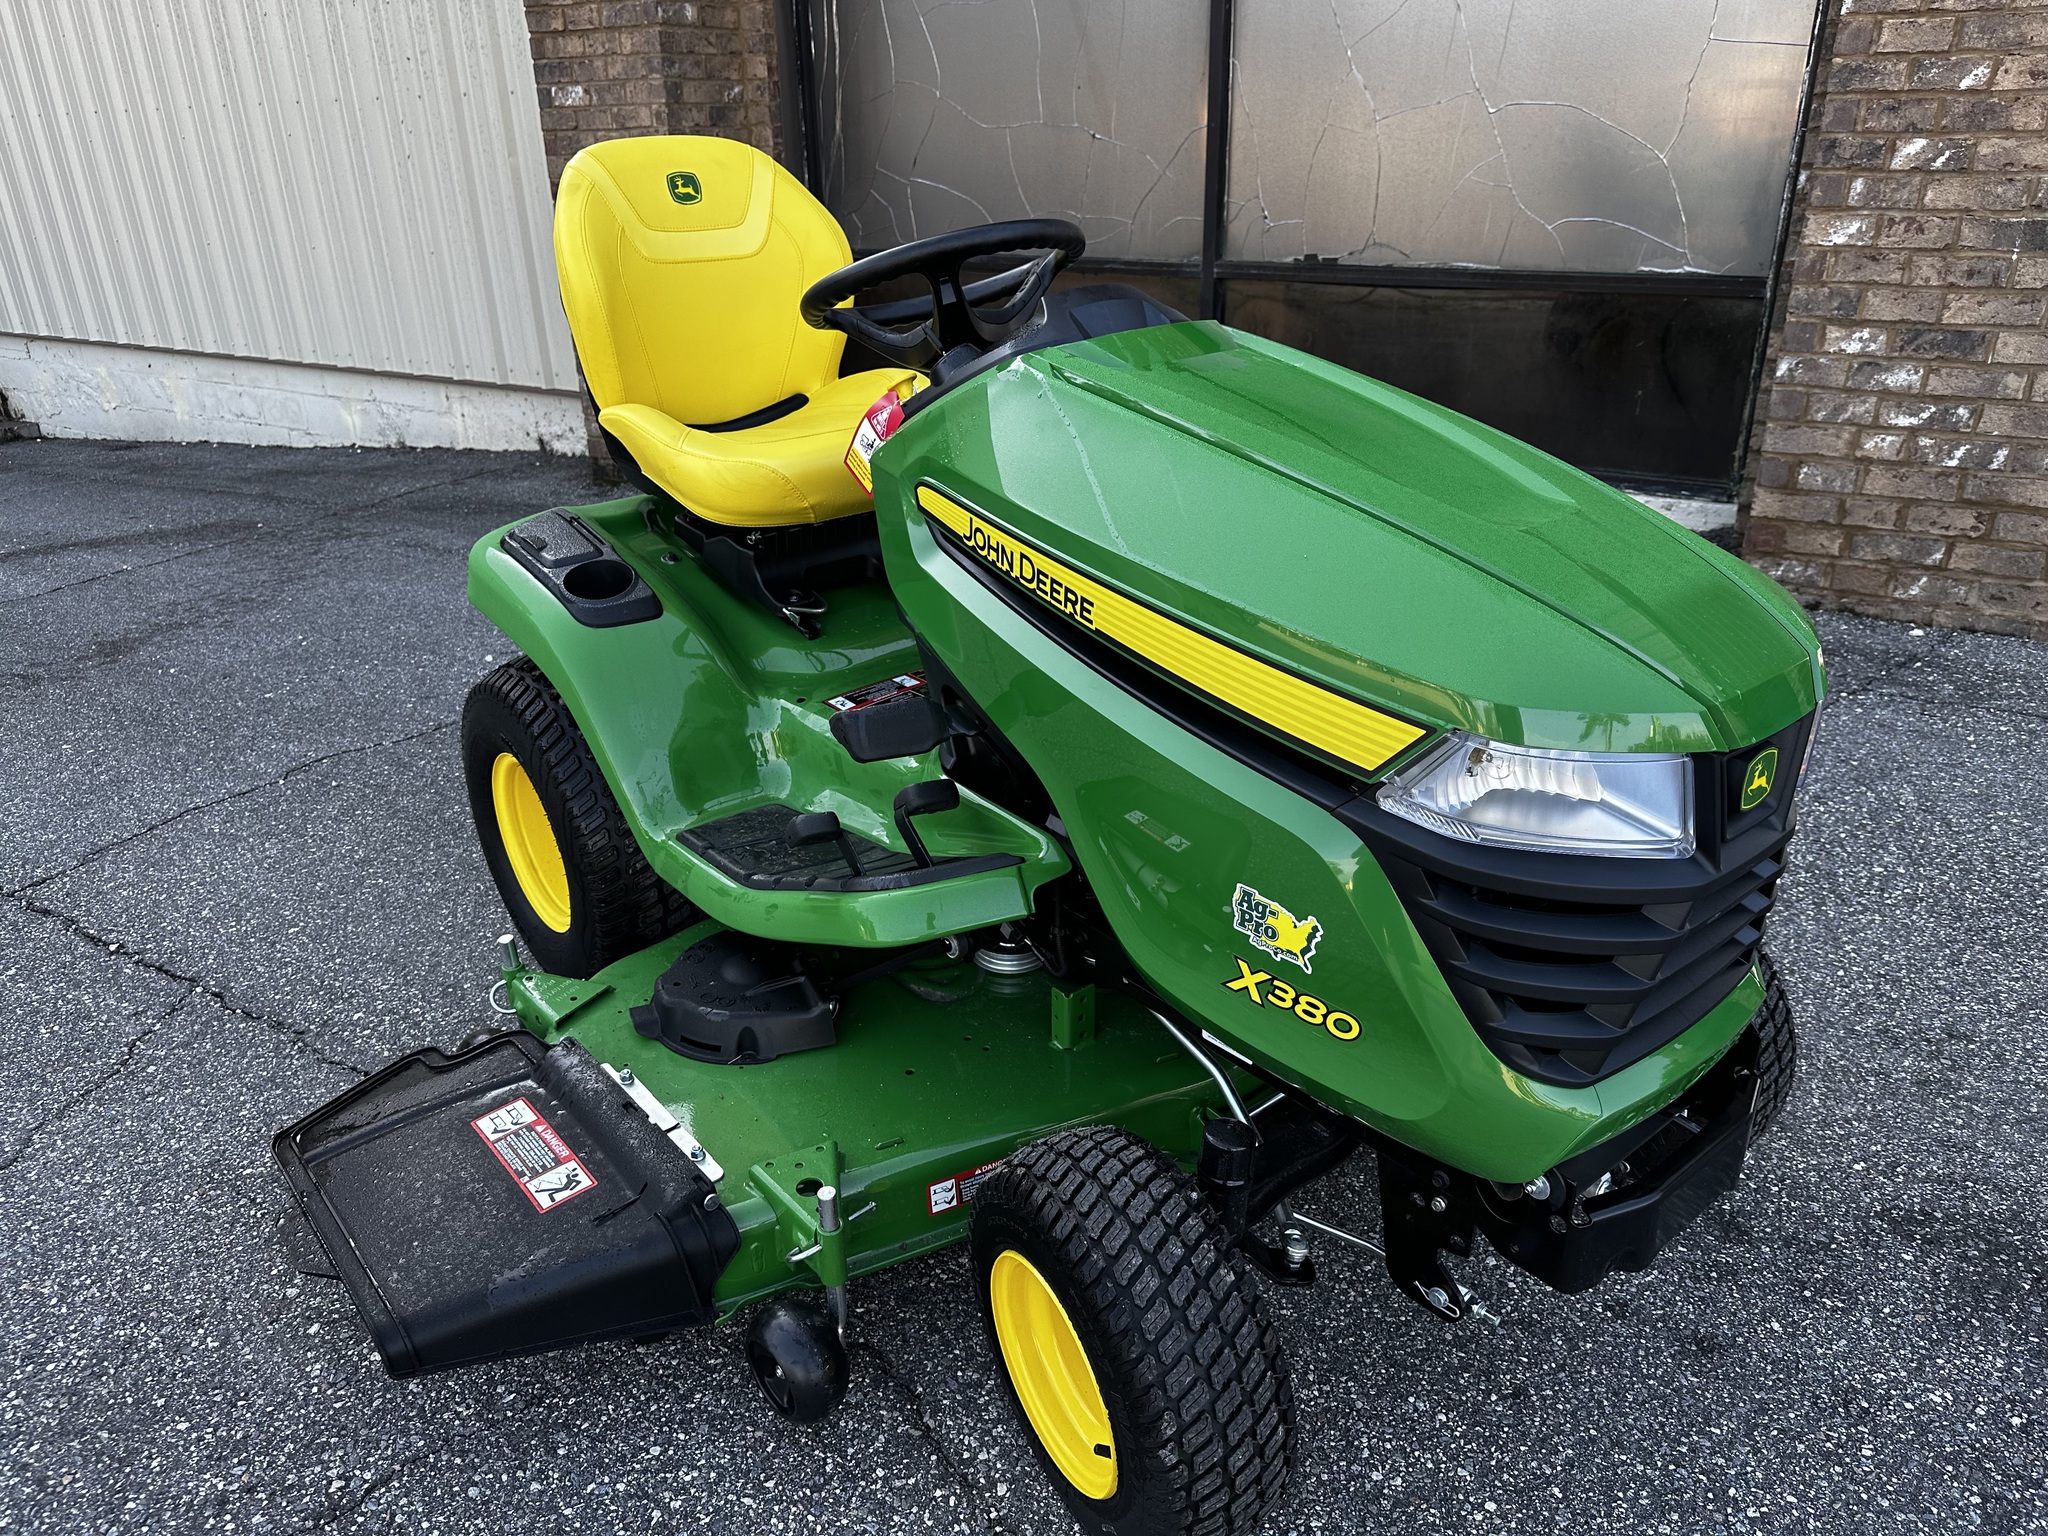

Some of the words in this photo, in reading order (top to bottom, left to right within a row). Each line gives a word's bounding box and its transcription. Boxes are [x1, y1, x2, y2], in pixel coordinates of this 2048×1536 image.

[963, 516, 1014, 575] JOHN
[1019, 550, 1095, 627] DEERE
[1237, 888, 1278, 920] Ag-
[1238, 908, 1278, 941] Pro
[1252, 936, 1299, 961] AgProCo.com
[1222, 956, 1362, 1041] X380
[541, 1128, 570, 1158] DANGER
